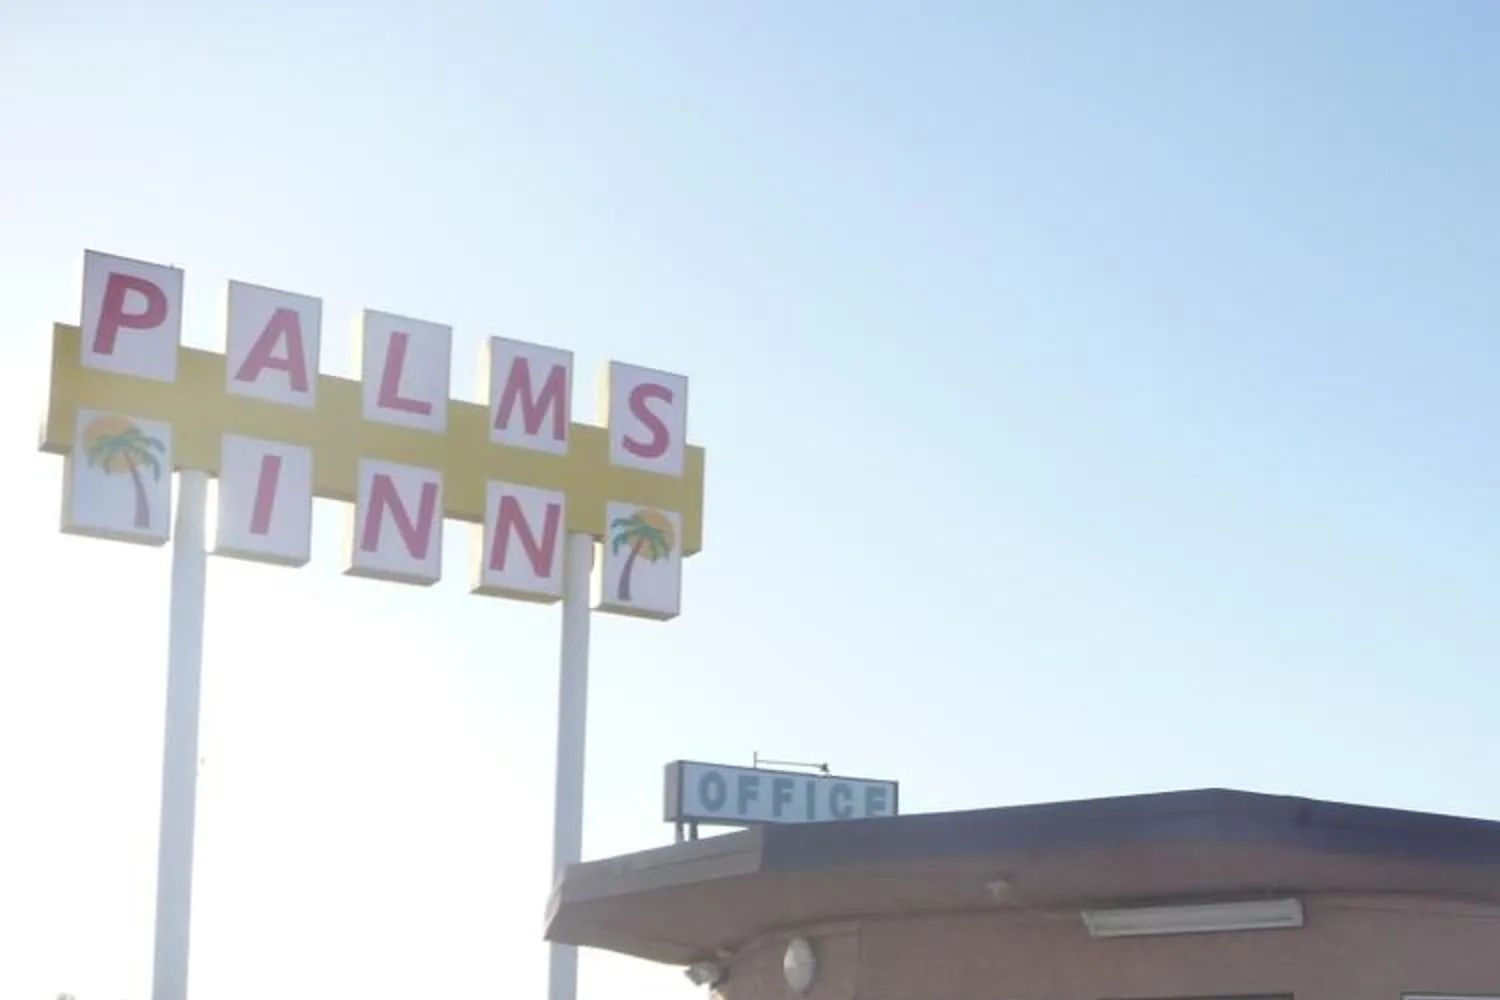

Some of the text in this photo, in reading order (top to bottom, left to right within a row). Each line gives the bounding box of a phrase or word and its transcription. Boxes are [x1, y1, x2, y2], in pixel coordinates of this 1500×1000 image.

[92, 271, 673, 458] PALMS
[249, 453, 561, 577] INN
[699, 770, 887, 820] OFFICE
